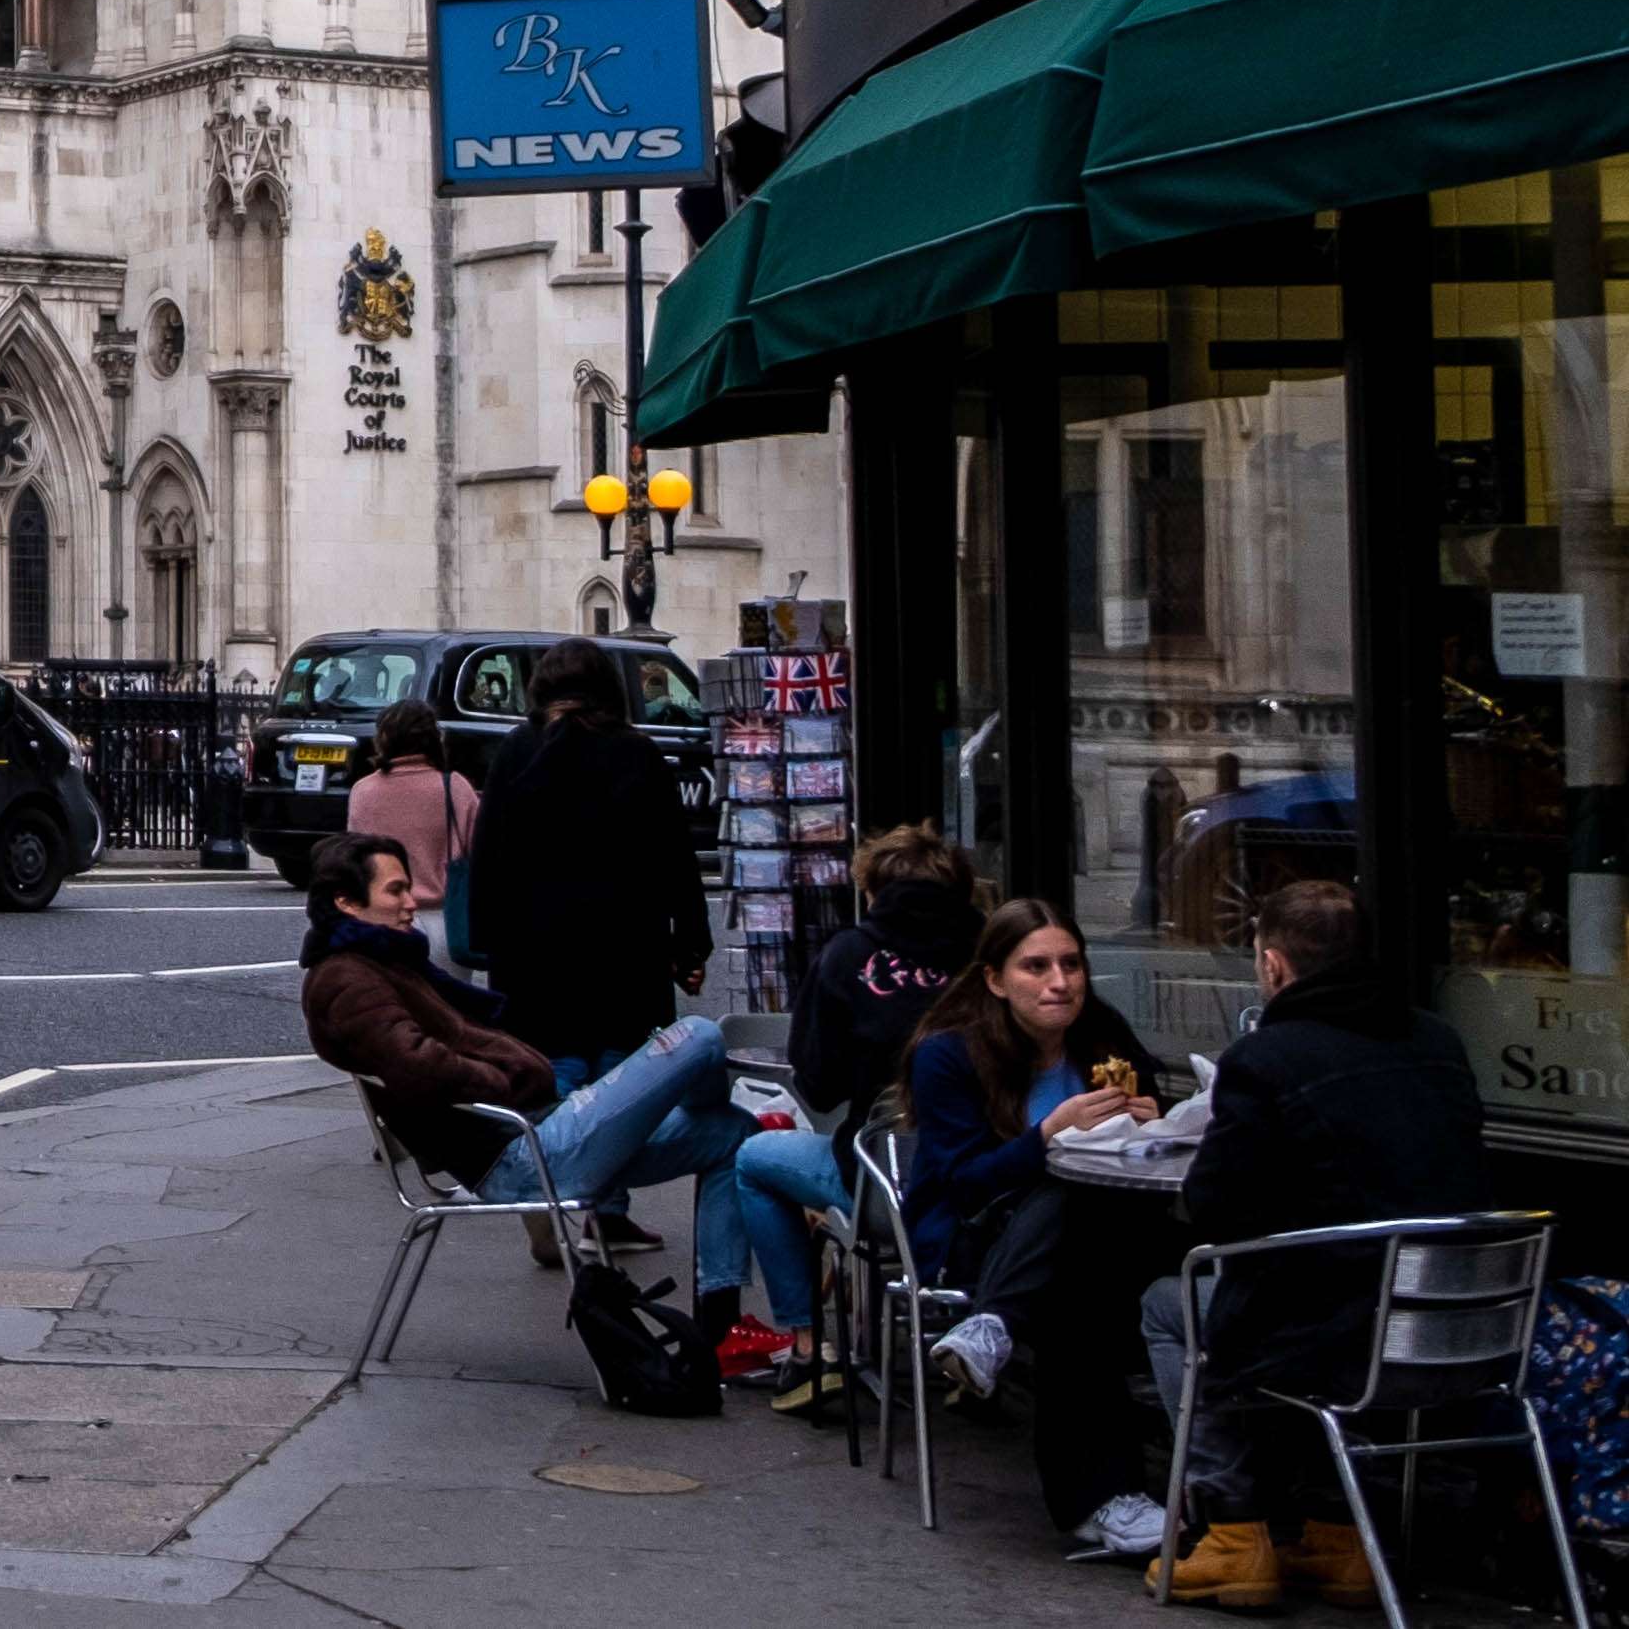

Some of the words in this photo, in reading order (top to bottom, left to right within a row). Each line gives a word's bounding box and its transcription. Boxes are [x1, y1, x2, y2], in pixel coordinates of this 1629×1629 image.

[454, 127, 684, 169] NEWS
[354, 343, 392, 364] The
[348, 365, 400, 390] Royal
[344, 387, 406, 408] Courts
[364, 410, 386, 430] of
[343, 430, 407, 454] Justice
